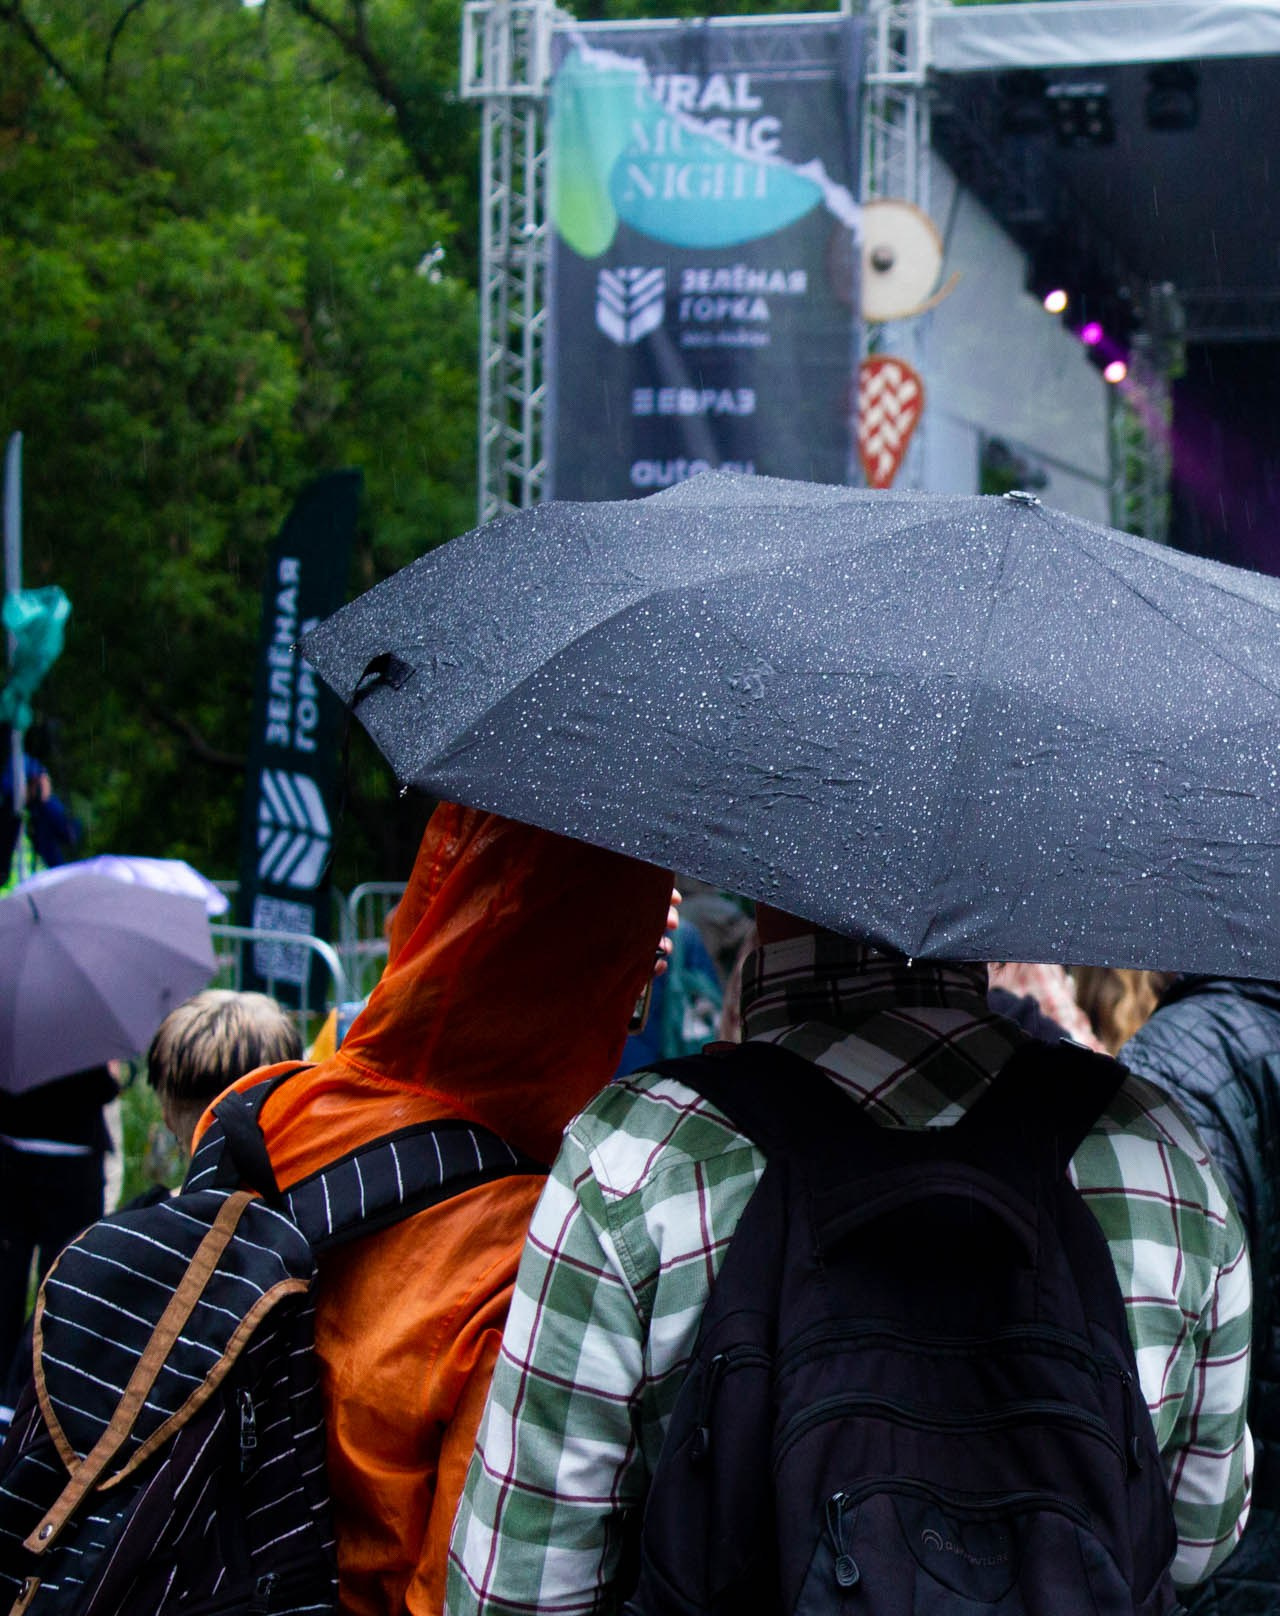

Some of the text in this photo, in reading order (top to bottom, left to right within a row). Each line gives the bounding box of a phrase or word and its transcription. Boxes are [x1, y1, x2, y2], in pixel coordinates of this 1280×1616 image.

[623, 162, 771, 199] NIGHT
[681, 264, 808, 293] ЗЕЛЁНАЯ
[679, 297, 771, 322] ГОРКА
